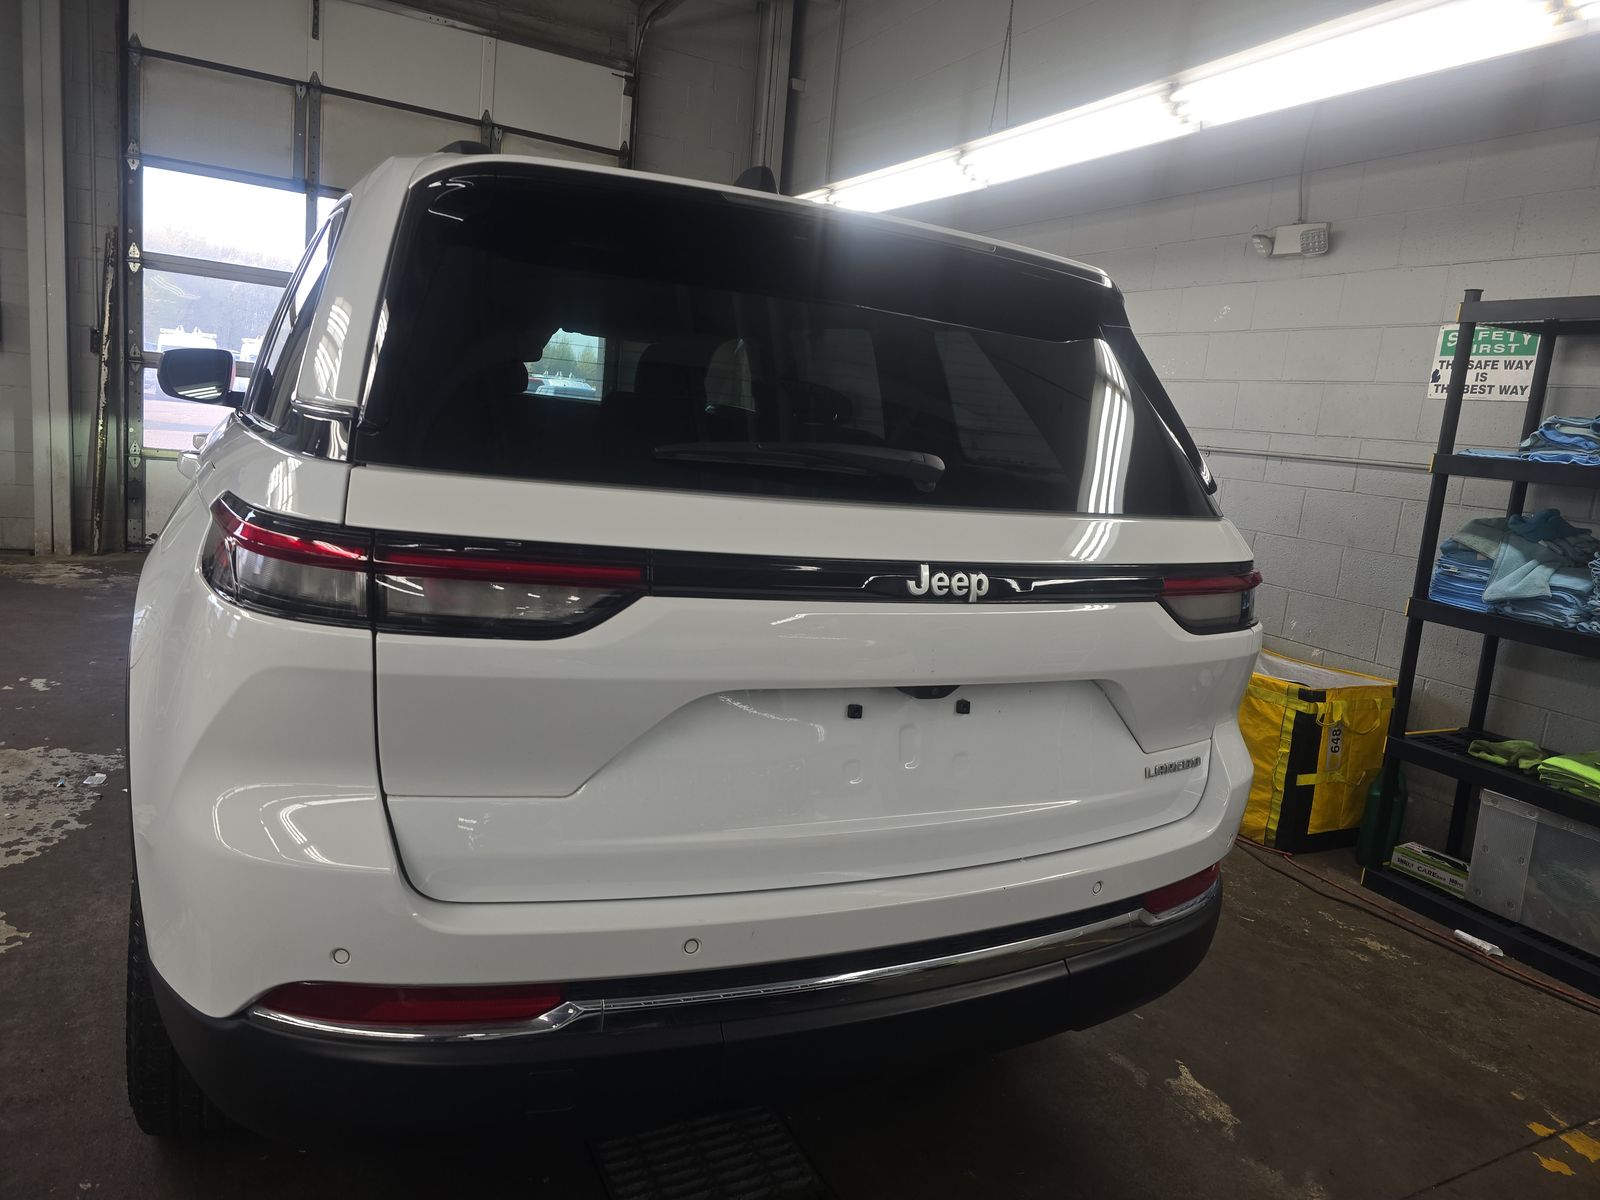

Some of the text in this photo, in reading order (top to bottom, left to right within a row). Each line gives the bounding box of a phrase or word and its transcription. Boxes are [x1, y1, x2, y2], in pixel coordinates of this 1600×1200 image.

[1447, 331, 1532, 347] SFETY
[1471, 343, 1520, 353] IRST
[1438, 360, 1534, 370] TH SAFE WAY
[1474, 372, 1488, 382] IS
[1434, 384, 1529, 396] TH BEST WAY
[906, 563, 989, 602] Jeep
[1330, 729, 1342, 753] 648
